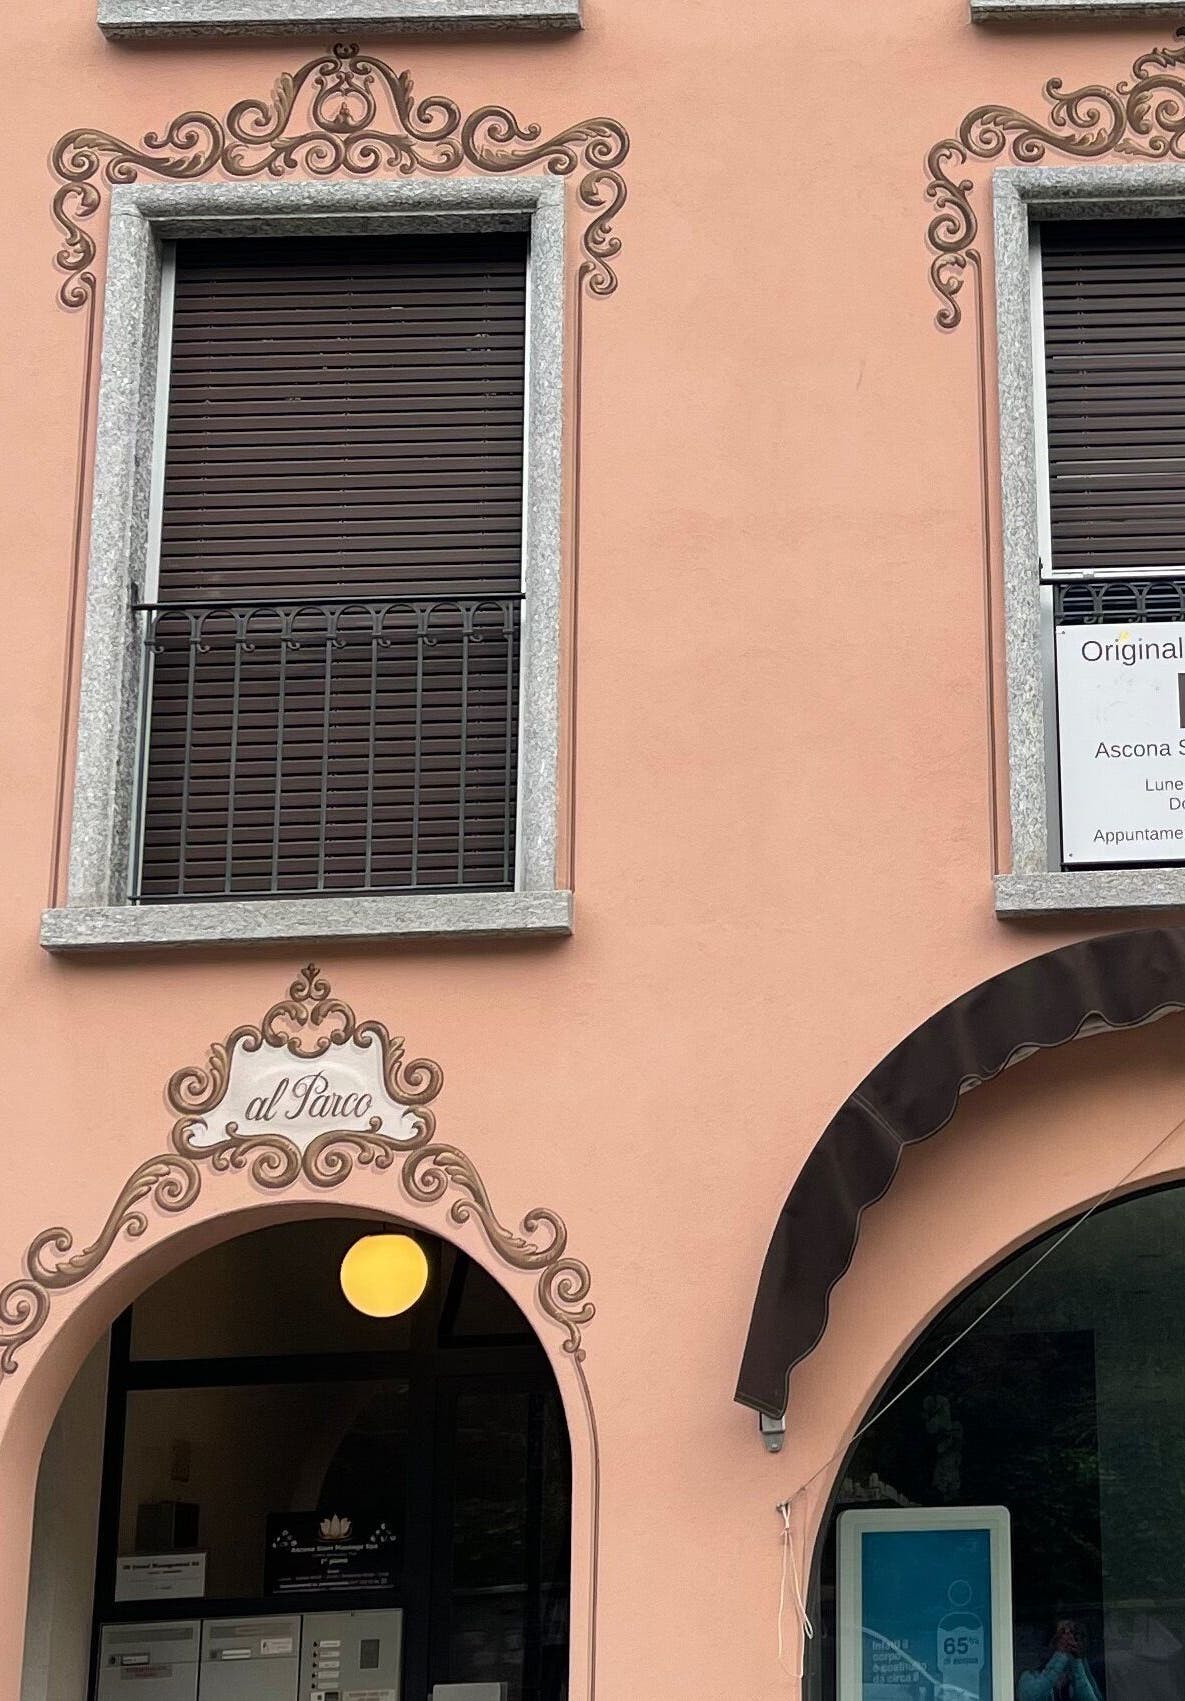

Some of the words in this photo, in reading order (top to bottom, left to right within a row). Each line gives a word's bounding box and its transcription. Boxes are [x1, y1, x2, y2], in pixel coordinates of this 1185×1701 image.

[1081, 637, 1183, 666] Original
[1095, 741, 1171, 758] Ascona
[245, 1077, 290, 1121] al
[285, 1069, 373, 1120] Parco
